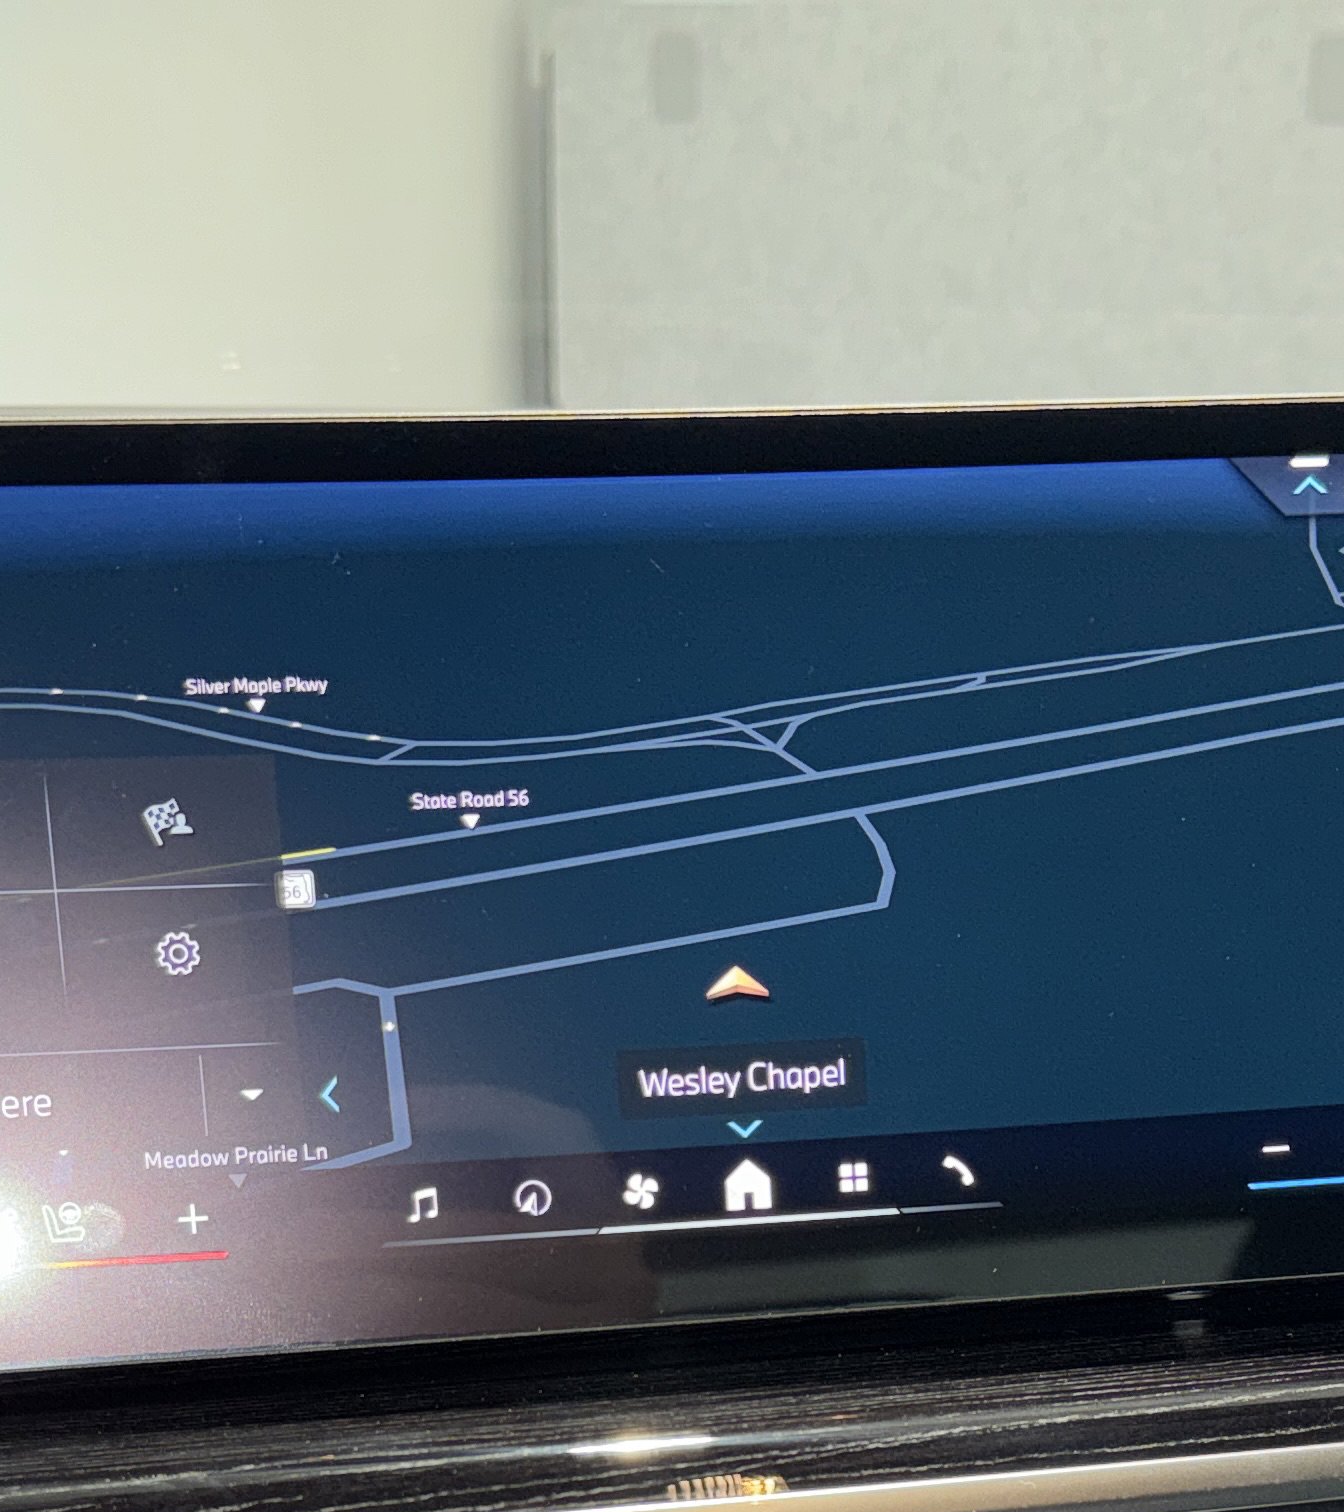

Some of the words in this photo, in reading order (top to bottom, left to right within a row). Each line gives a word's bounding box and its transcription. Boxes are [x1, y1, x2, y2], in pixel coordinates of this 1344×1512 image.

[184, 677, 230, 696] Silver
[233, 676, 282, 697] Maple
[285, 675, 328, 695] Pkwy
[410, 791, 457, 810] State
[459, 790, 505, 808] Road
[507, 788, 530, 807] 56
[637, 1065, 741, 1098] Wesley
[746, 1057, 846, 1094] Chapel
[143, 1149, 229, 1170] Meadow
[234, 1144, 298, 1165] Prairie
[302, 1143, 329, 1162] Ln
